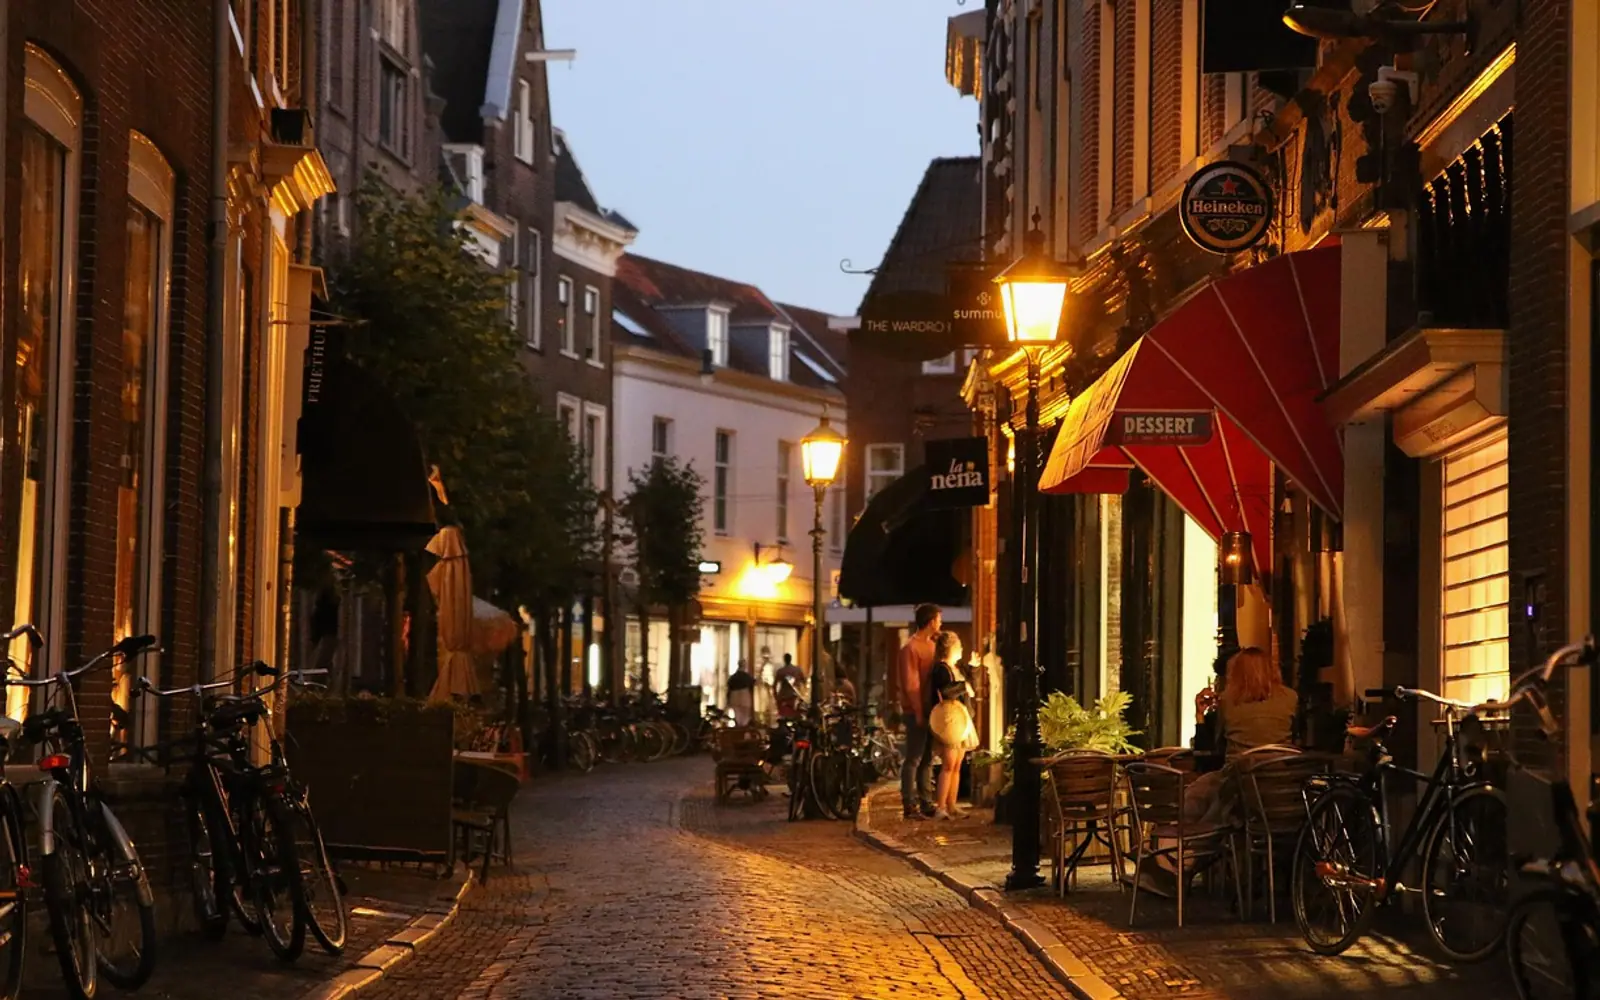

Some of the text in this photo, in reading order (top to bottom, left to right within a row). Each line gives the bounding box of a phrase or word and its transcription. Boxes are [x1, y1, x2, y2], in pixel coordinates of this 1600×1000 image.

[1192, 200, 1262, 214] Heineken
[866, 320, 889, 332] THE
[1124, 417, 1195, 433] DESSERT
